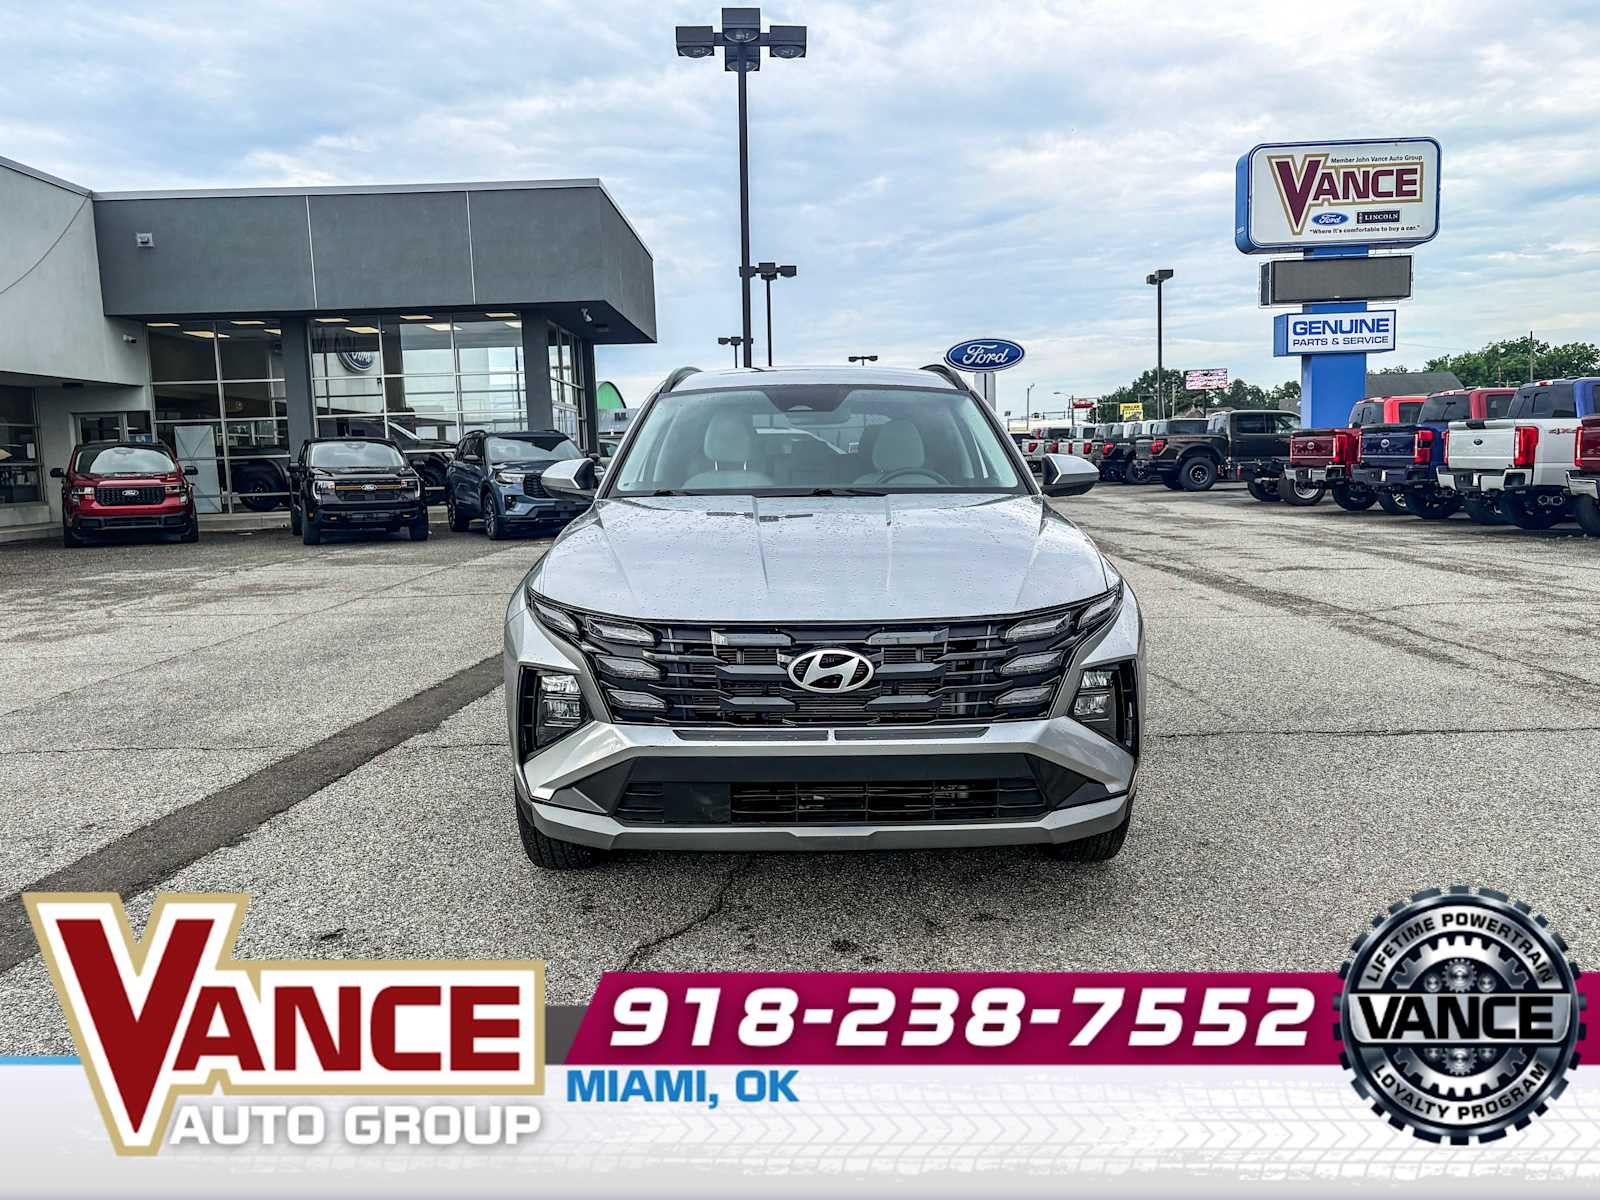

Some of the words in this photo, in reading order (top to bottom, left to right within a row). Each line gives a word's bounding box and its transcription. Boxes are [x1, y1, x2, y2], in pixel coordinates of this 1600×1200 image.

[1404, 154, 1423, 162] Group
[1275, 160, 1418, 229] VANCE
[1319, 214, 1342, 224] Ford
[1364, 213, 1399, 221] LINCOLN
[1292, 318, 1390, 336] GENUINE
[1293, 338, 1328, 346] PARTS
[1331, 337, 1340, 345] &
[1342, 336, 1389, 345] SERVICE
[962, 344, 1009, 364] Ford
